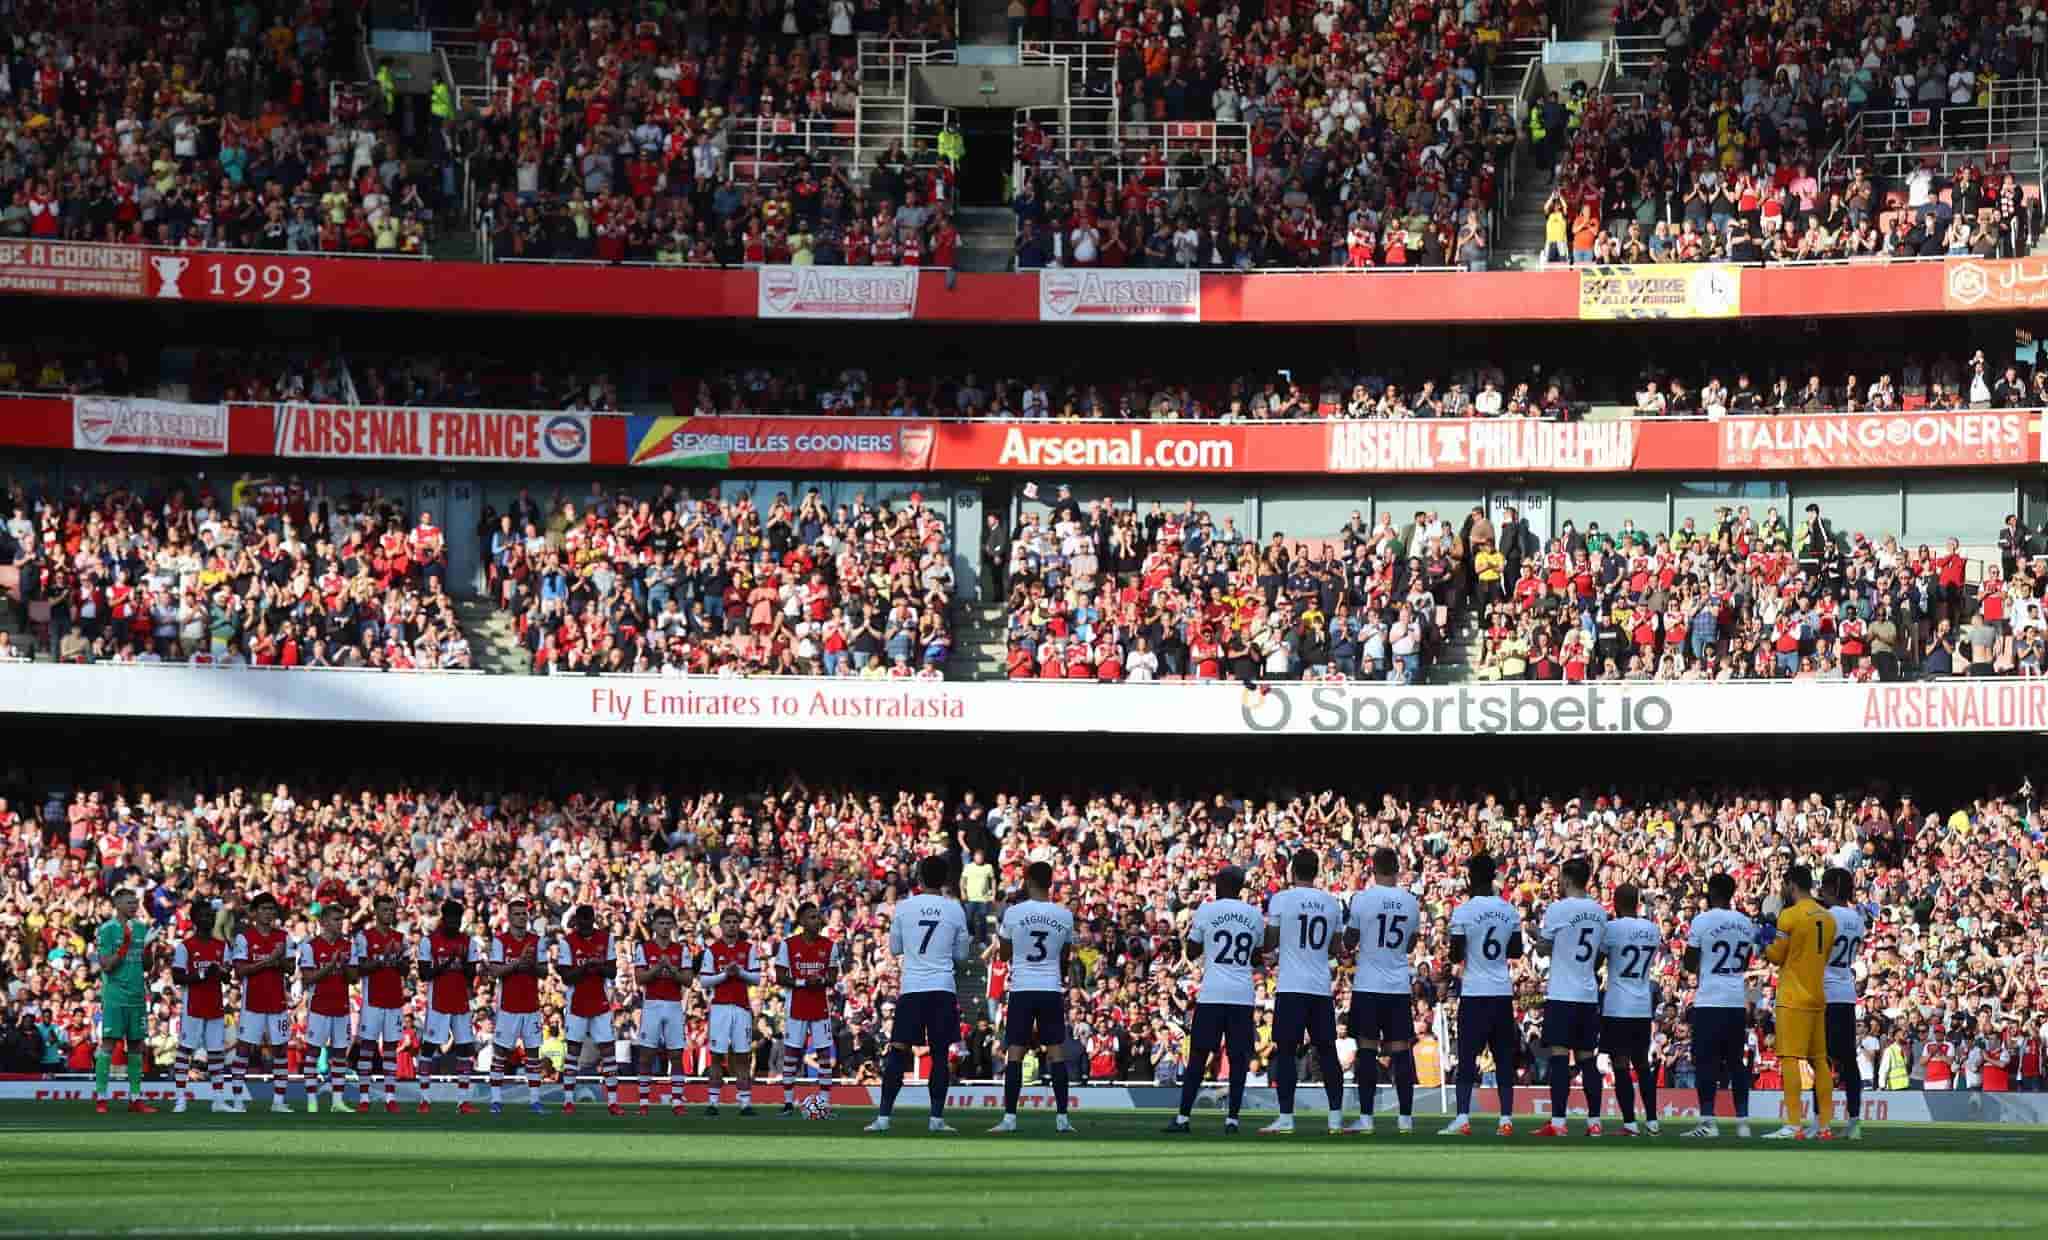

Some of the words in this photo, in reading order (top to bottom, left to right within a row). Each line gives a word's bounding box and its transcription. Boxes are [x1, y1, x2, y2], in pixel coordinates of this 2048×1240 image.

[32, 245, 45, 265] A
[51, 247, 142, 271] GOONER!
[208, 263, 311, 299] 1993
[801, 269, 914, 301] Arsenal
[1081, 271, 1198, 304] Arsenal
[112, 402, 225, 439] Arsenal
[292, 408, 422, 456] ARSENAL
[430, 411, 541, 458] FRANCE
[1727, 419, 1849, 450] ITALIAN
[1857, 414, 2020, 447] GOONERS
[671, 432, 788, 451] SEYCHELLES
[796, 434, 893, 451] GOONERS
[1000, 427, 1234, 468] Arsenal.com
[1329, 421, 1434, 470] ARSENAL
[1469, 421, 1633, 468] PHILADELPHIA
[591, 688, 632, 721] Fly
[643, 688, 761, 717] Emirates
[771, 694, 799, 717] to
[809, 690, 965, 719] Australasia
[1309, 686, 1674, 732] Sportsbet.io
[918, 919, 940, 955] 7
[1026, 930, 1049, 962] 3
[1213, 929, 1253, 966] 28
[1298, 914, 1328, 950] 10
[1376, 913, 1408, 949] 15
[1482, 925, 1501, 961] 6
[1575, 927, 1594, 962] 5
[1815, 920, 1825, 954] 1
[1618, 944, 1657, 981] 27
[1711, 940, 1752, 974] 25
